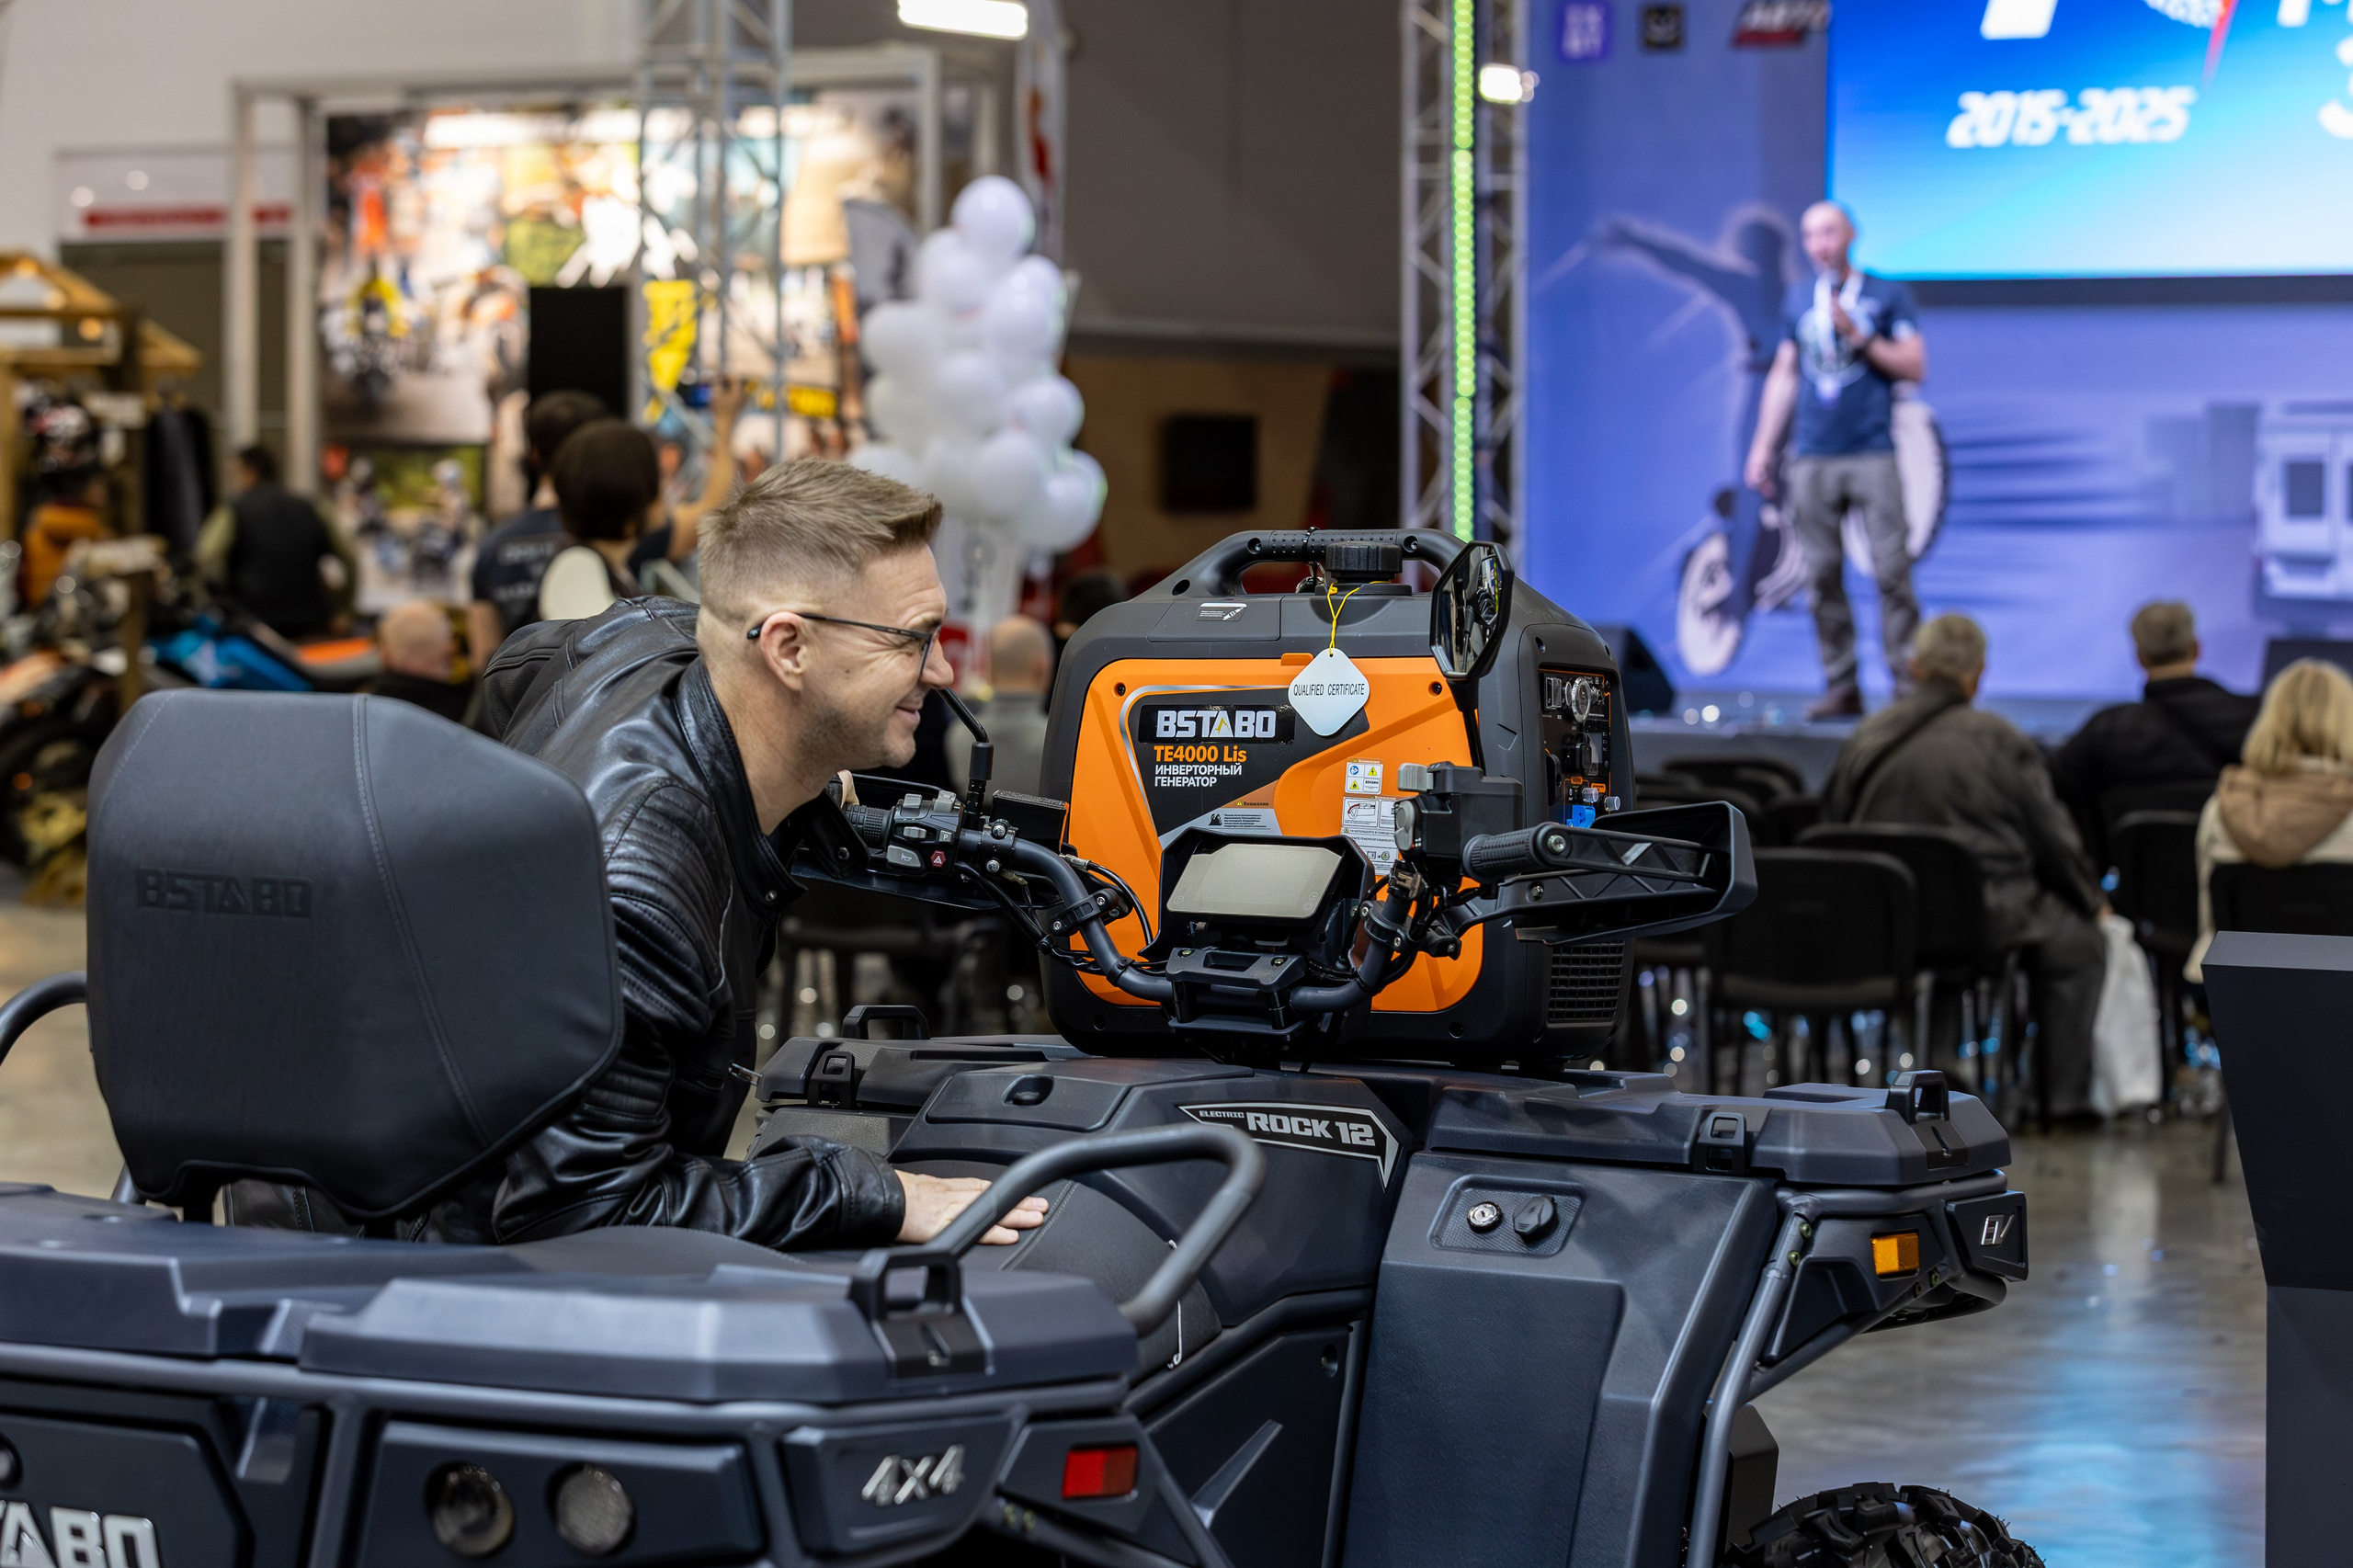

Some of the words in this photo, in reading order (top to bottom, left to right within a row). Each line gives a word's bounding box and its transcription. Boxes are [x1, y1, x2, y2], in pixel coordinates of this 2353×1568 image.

[1946, 85, 2197, 148] 2015-2025
[1293, 684, 1324, 696] QUALIFIED
[1327, 683, 1365, 696] CERTIFICATE
[1155, 710, 1277, 738] BSTABO
[1154, 744, 1219, 762] TE4000
[1223, 744, 1247, 762] Lis
[1154, 763, 1243, 776] ИНВЕРТОРНЫЙ
[1154, 776, 1218, 788] ГЕНЕРАТОР
[137, 867, 313, 918] BSTABO
[1199, 1109, 1245, 1119] ELECTRIC
[1246, 1111, 1333, 1139] ROCK
[1335, 1121, 1376, 1147] 12
[0, 1500, 164, 1568] ABO
